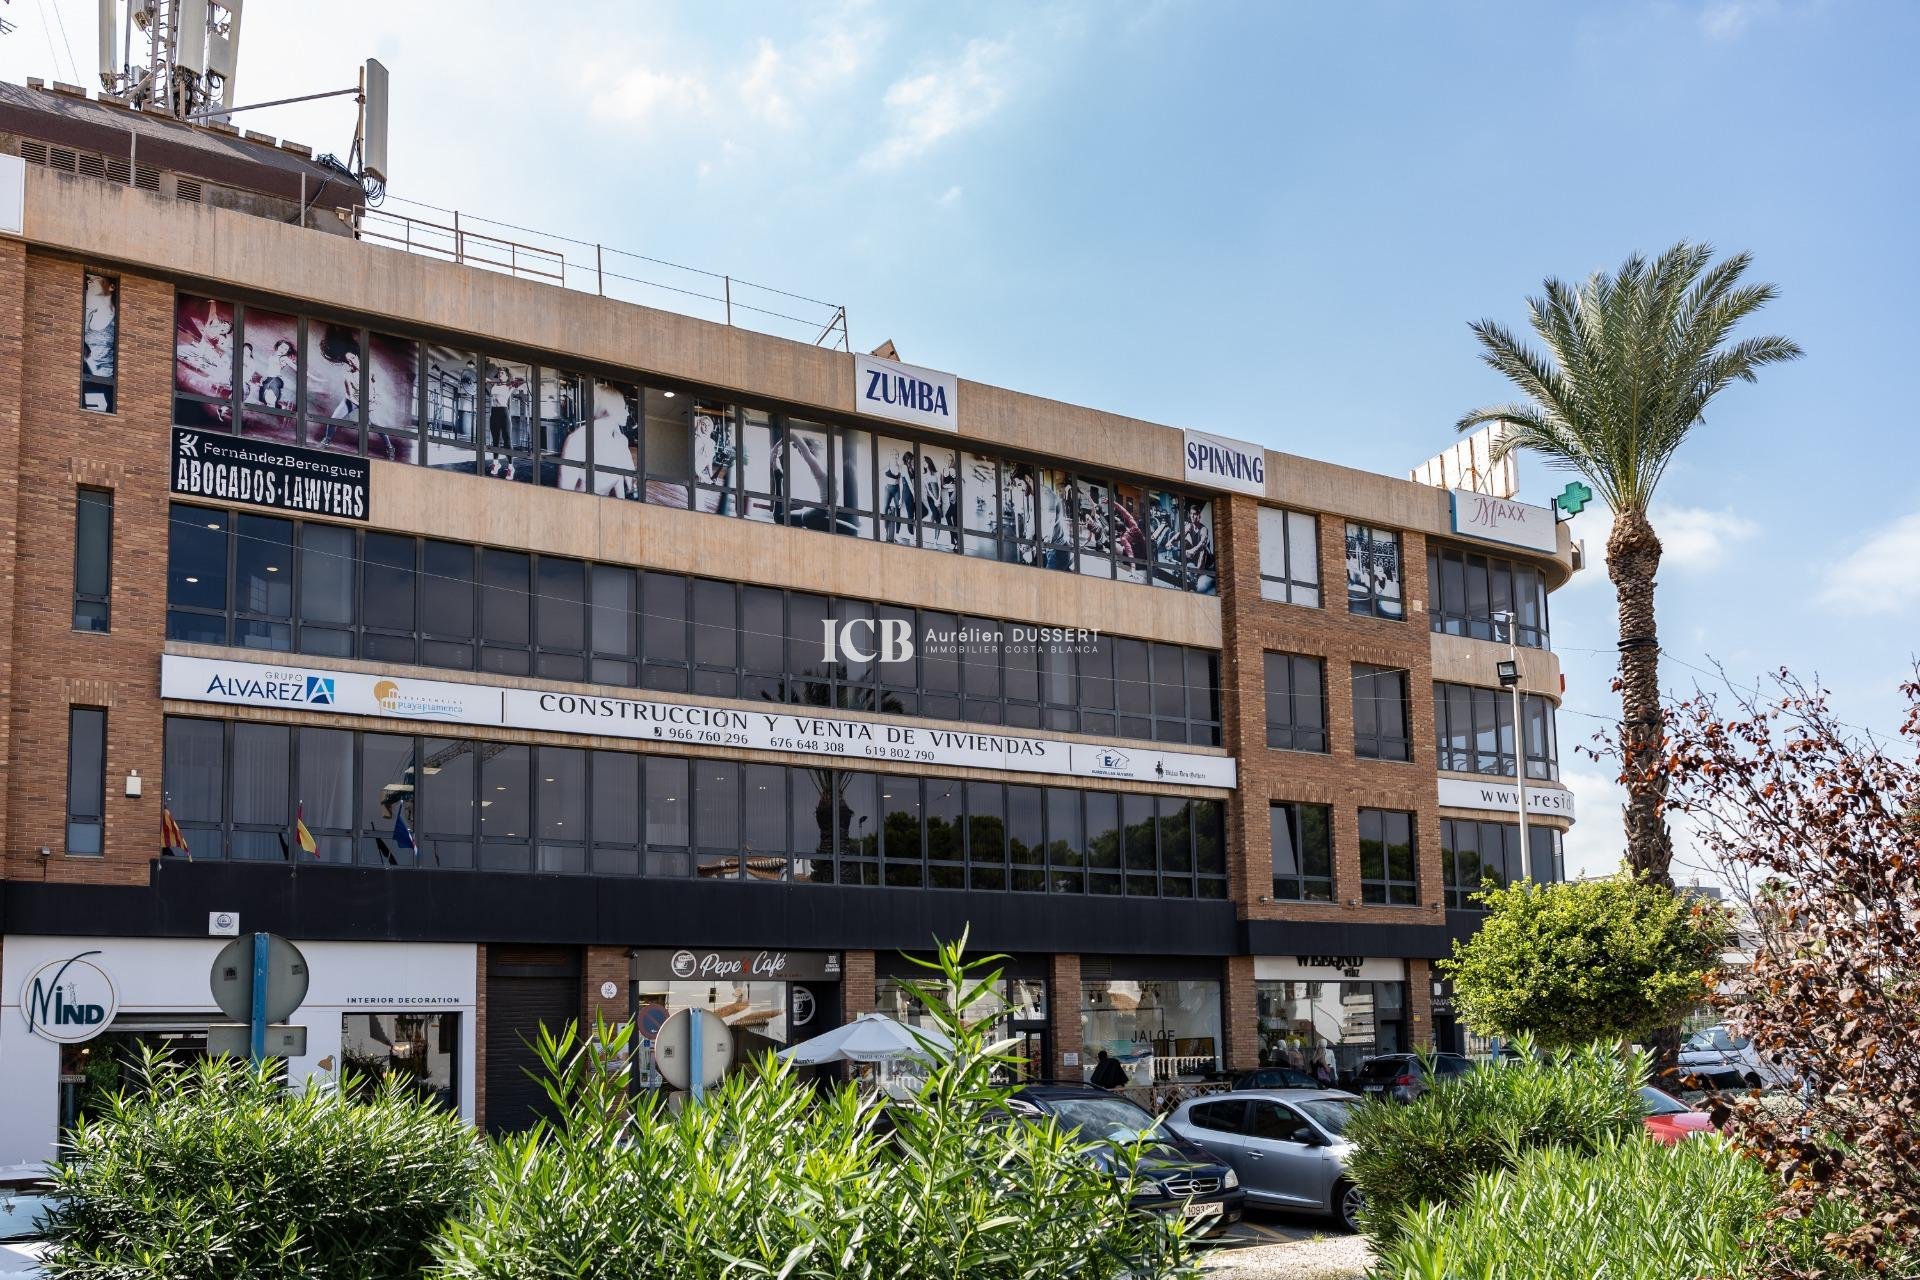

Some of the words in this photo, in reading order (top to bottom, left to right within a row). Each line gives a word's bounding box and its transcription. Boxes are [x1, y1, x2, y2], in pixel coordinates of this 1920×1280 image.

[866, 369, 949, 416] ZUMBA
[203, 442, 364, 479] FernándezBerenguer
[1187, 441, 1264, 484] SPINNING
[206, 674, 304, 702] ALVAREZ
[265, 671, 303, 682] GRUPO
[539, 694, 748, 730] CONSTRUCCIÓN
[763, 715, 780, 732] Y
[795, 718, 872, 740] VENTA
[887, 727, 915, 745] DE
[930, 731, 1046, 757] VIVIENDAS
[669, 727, 694, 740] 966
[697, 729, 721, 742] 760
[725, 732, 749, 745] 296
[770, 737, 793, 748] 676
[797, 739, 819, 750] 648
[823, 741, 844, 753] 308
[865, 745, 887, 756] 619
[890, 747, 911, 759] 802
[914, 749, 935, 761] 790
[752, 950, 787, 978] Café
